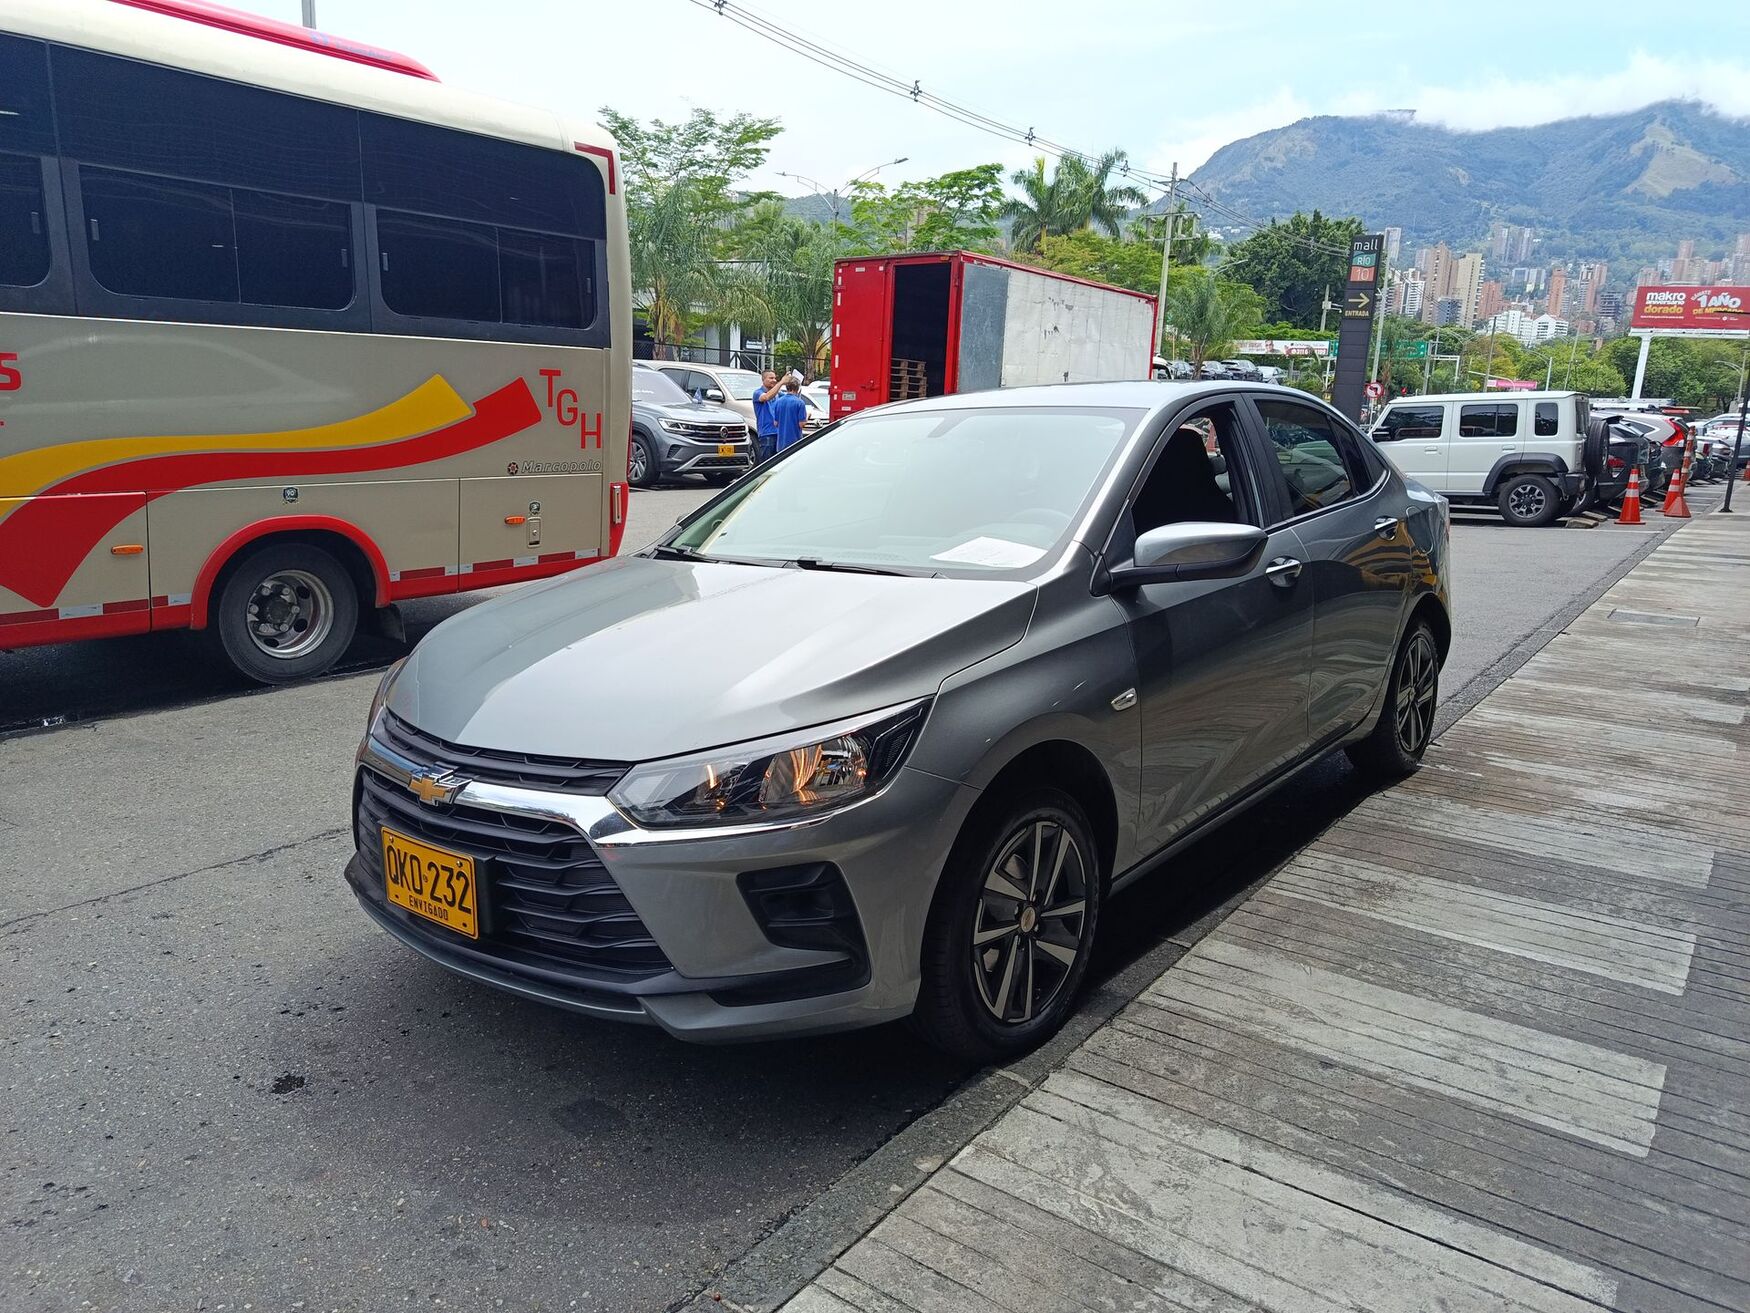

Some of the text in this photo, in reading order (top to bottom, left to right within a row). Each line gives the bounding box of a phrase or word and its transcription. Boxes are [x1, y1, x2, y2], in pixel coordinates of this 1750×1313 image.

[1353, 239, 1378, 251] mall
[1355, 268, 1370, 281] 10
[1646, 291, 1687, 301] makro
[1697, 292, 1741, 309] 1 AÑO
[1643, 305, 1684, 314] dorado
[539, 369, 602, 449] TGH
[521, 460, 602, 474] Marcopolo
[409, 894, 449, 921] ENVIGADO
